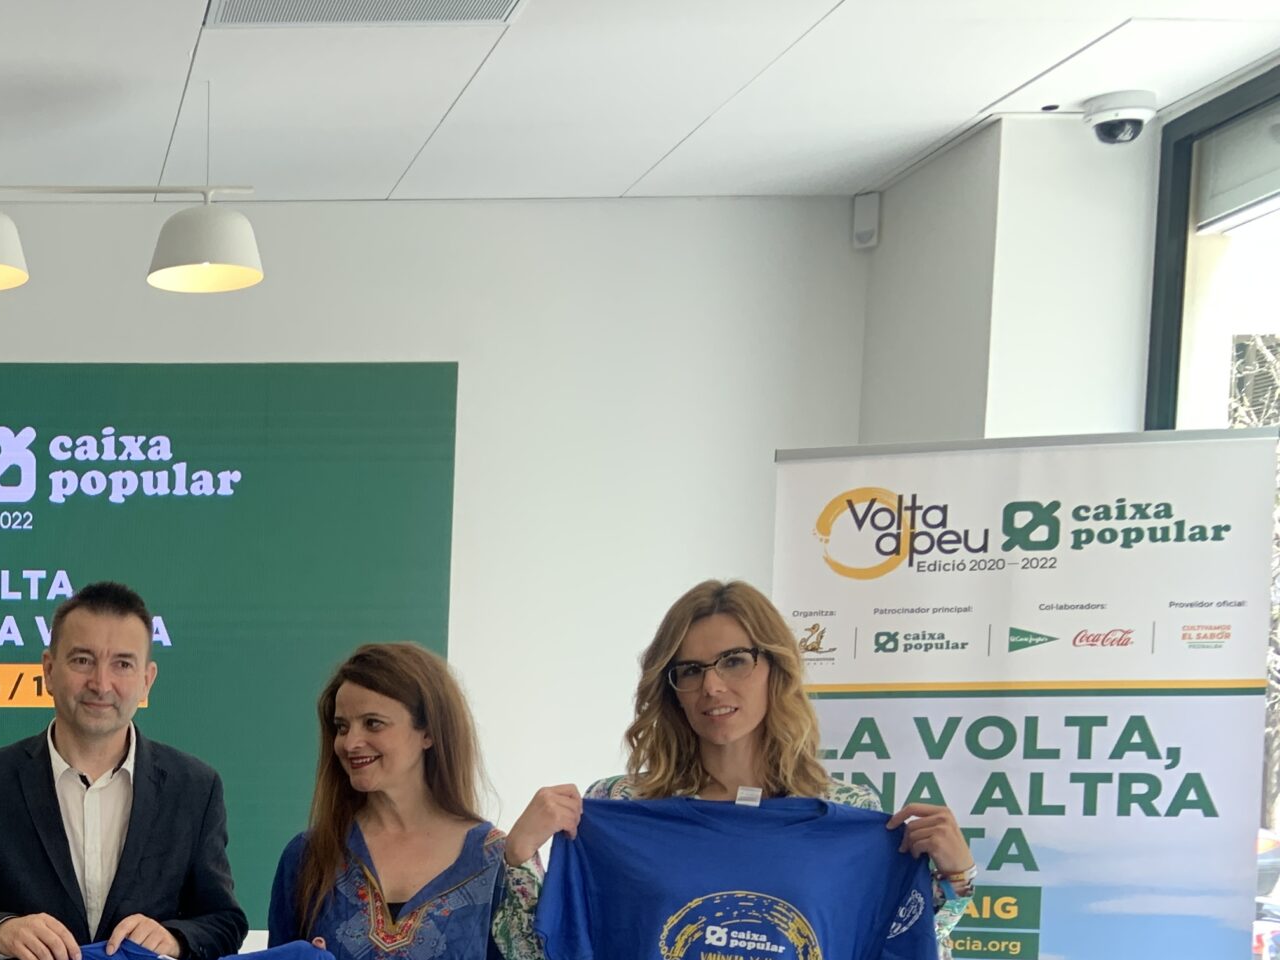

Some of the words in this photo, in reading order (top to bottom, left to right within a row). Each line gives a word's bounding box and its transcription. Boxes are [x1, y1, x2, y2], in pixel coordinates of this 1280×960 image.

[49, 426, 172, 461] caixa
[48, 462, 242, 503] popular
[846, 494, 948, 531] Volta
[1072, 498, 1174, 523] caixa
[1070, 520, 1231, 550] popular
[917, 558, 966, 573] Edició
[792, 610, 836, 618] Organitza:
[873, 607, 930, 615] Patrocinador
[932, 606, 973, 614] principal:
[903, 631, 945, 640] caixa
[1196, 632, 1231, 640] SABOR
[903, 640, 969, 652] popular
[913, 716, 1181, 770] VOLTA,
[970, 772, 1219, 817] ALTRA
[730, 930, 767, 942] caixa
[729, 939, 786, 954] popular
